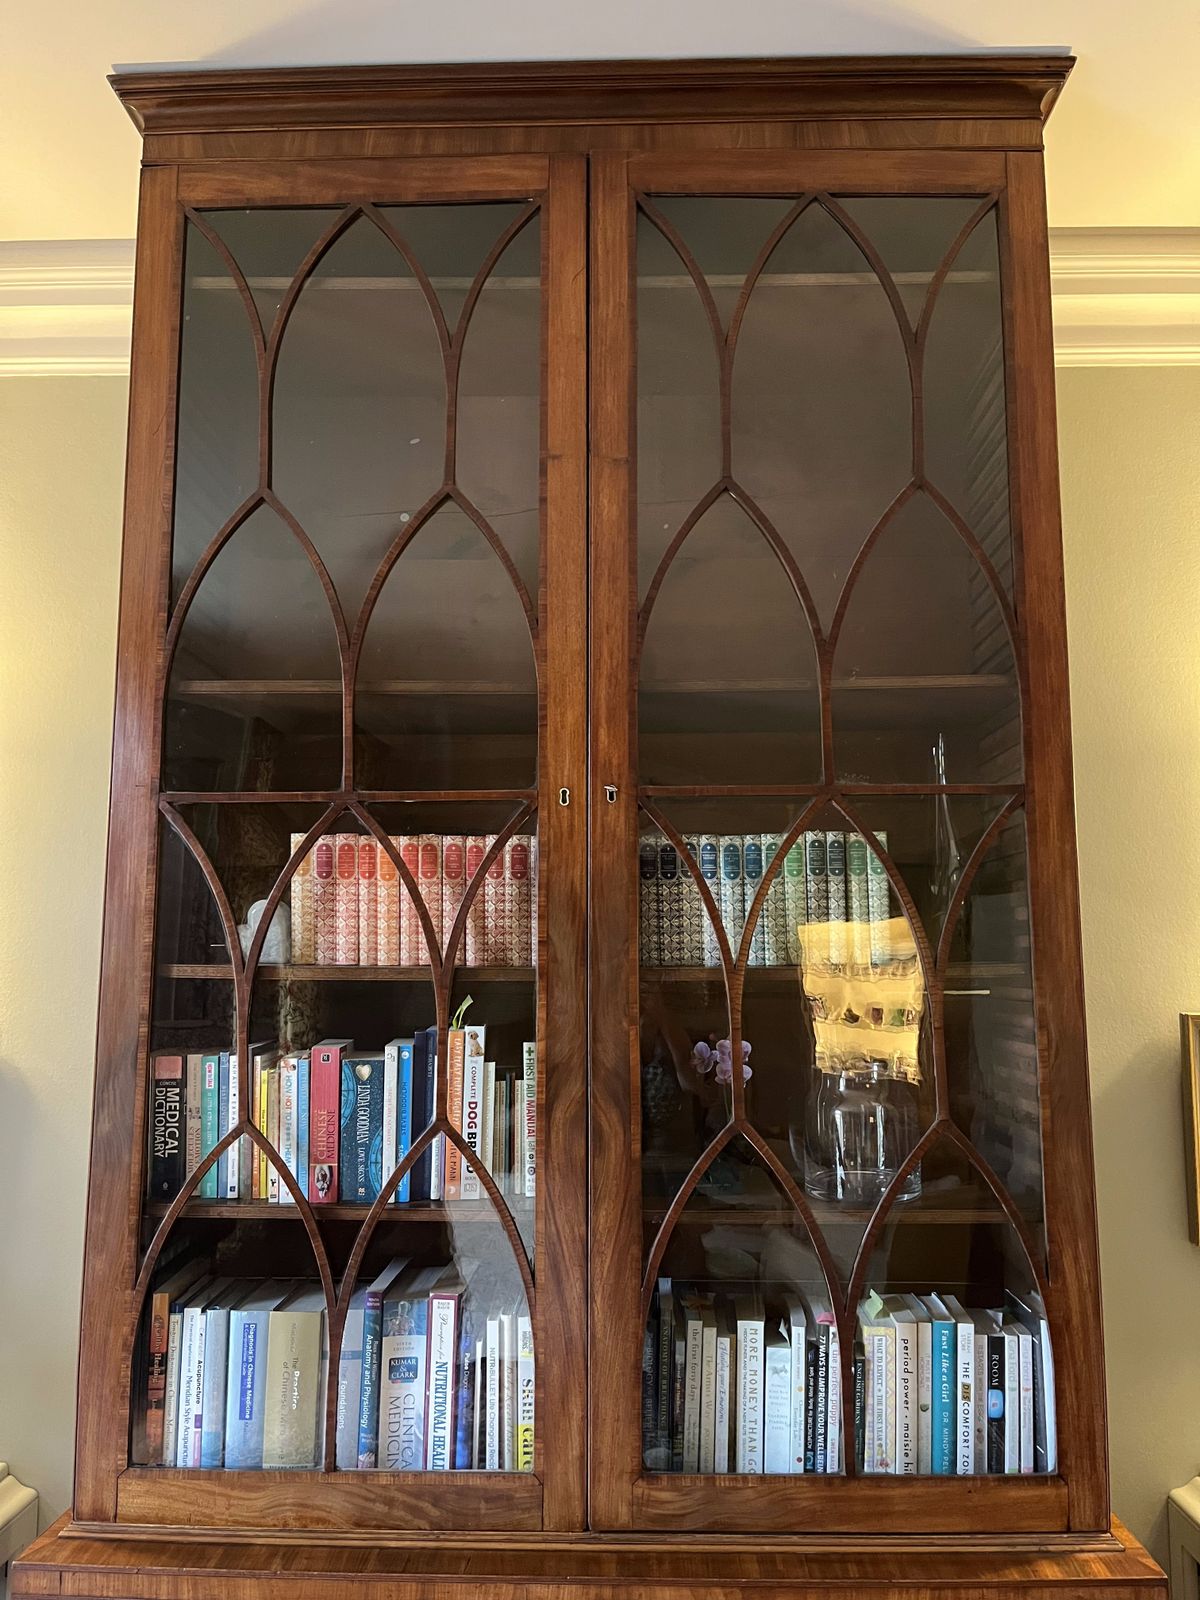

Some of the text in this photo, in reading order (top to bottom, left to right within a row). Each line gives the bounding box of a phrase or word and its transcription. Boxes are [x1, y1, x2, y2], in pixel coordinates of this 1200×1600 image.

[357, 1085, 370, 1144] LINDA GOODMAN
[467, 1101, 478, 1129] DOG
[526, 1058, 535, 1139] FIRST AID MANUAL
[154, 1087, 166, 1158] DICTIONARY
[165, 1087, 180, 1158] MEDICAL
[318, 1109, 326, 1160] CHINESE
[327, 1110, 335, 1159] MEDICINE
[466, 1132, 477, 1173] BRD
[364, 1334, 373, 1368] Anatomy
[819, 1334, 826, 1343] 77
[152, 1353, 162, 1384] Healing
[662, 1366, 668, 1375] OF
[689, 1363, 698, 1382] forty
[819, 1366, 825, 1377] TO
[991, 1354, 999, 1386] ROOM
[1008, 1339, 1016, 1382] Gina Ford
[339, 1380, 348, 1429] Foundations
[361, 1386, 371, 1429] Physiology
[434, 1361, 448, 1433] NUTRITIONAL
[688, 1384, 697, 1400] days
[748, 1328, 758, 1473] MORE MONEY THAN GO
[901, 1338, 914, 1474] period power maisie hil
[183, 1408, 191, 1423] Style
[387, 1396, 400, 1469] MEDICIN
[401, 1393, 415, 1469] CLINICA
[432, 1435, 446, 1470] HEALI
